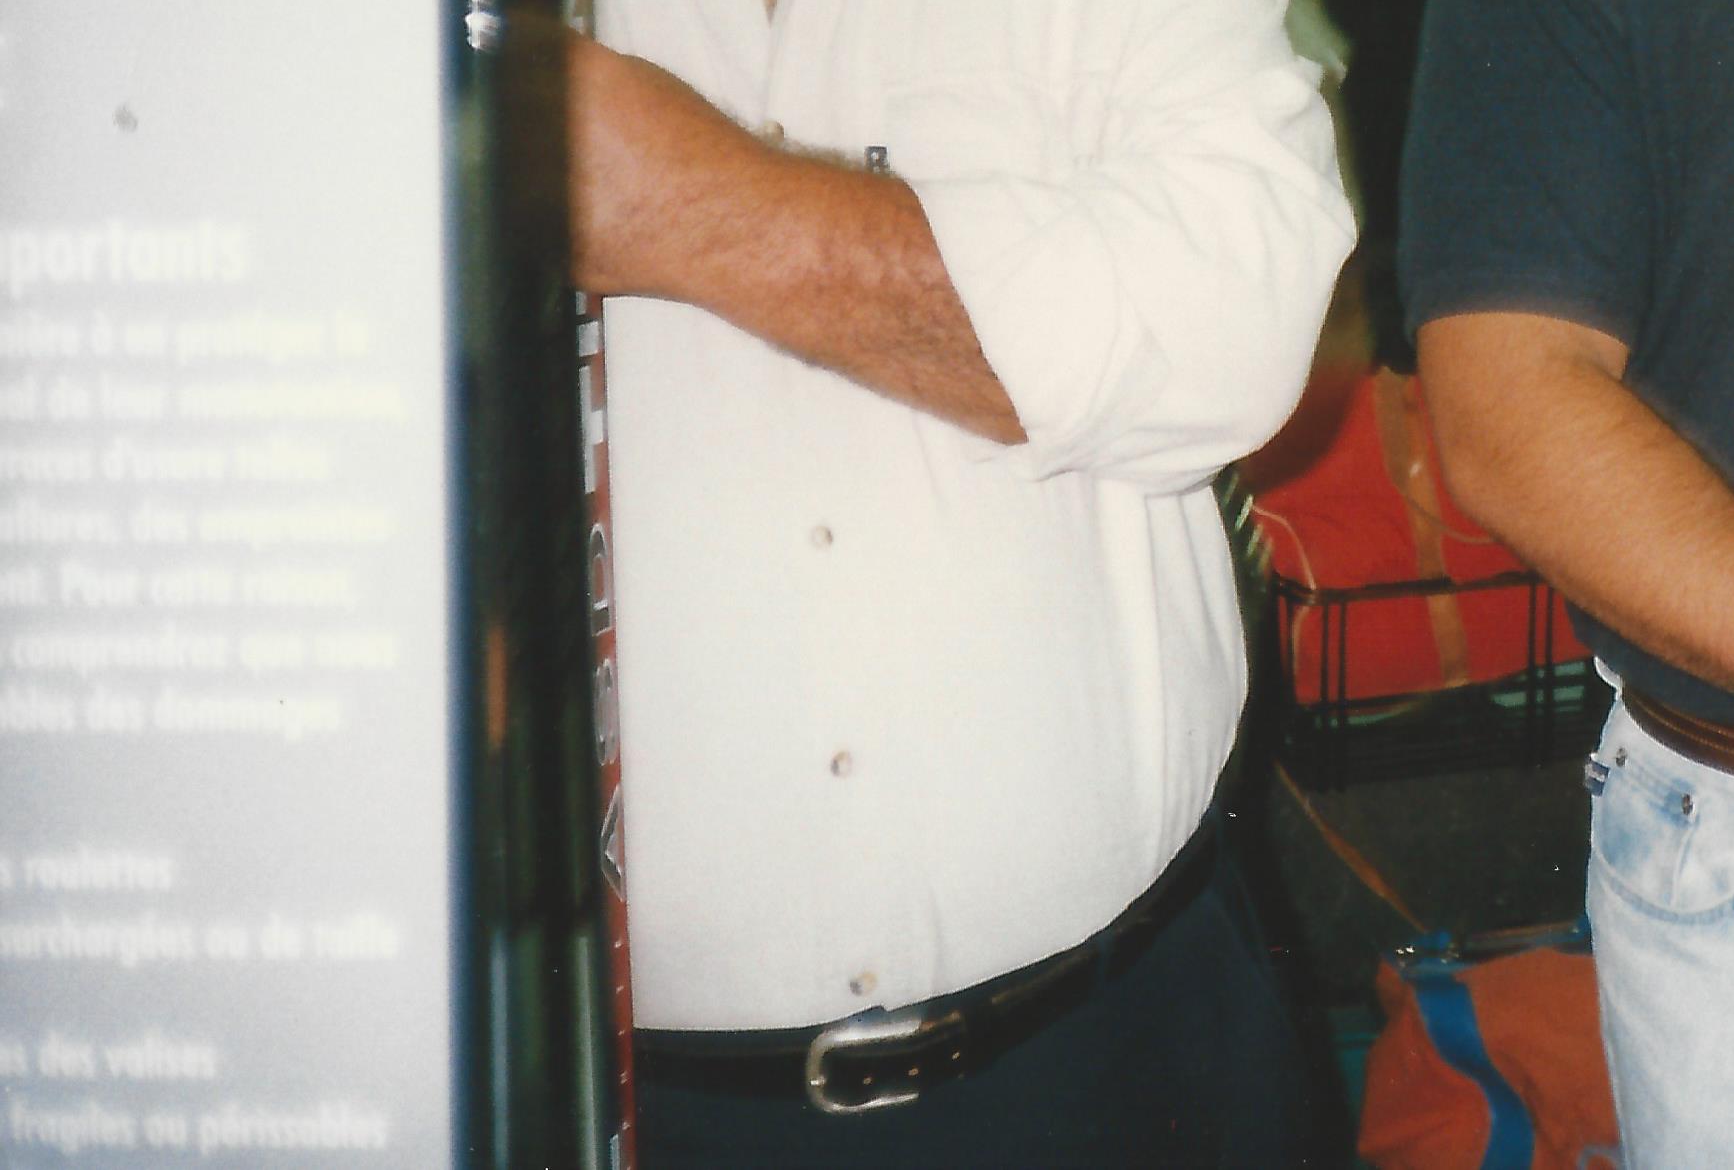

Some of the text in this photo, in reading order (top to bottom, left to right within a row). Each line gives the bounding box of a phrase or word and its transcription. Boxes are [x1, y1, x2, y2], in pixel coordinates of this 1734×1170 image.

[0, 216, 250, 299] portants
[59, 561, 138, 608] Pour
[85, 687, 144, 732] des
[205, 923, 250, 959] ou
[260, 910, 303, 959] de
[39, 1029, 96, 1079] des
[143, 1113, 189, 1149] ou
